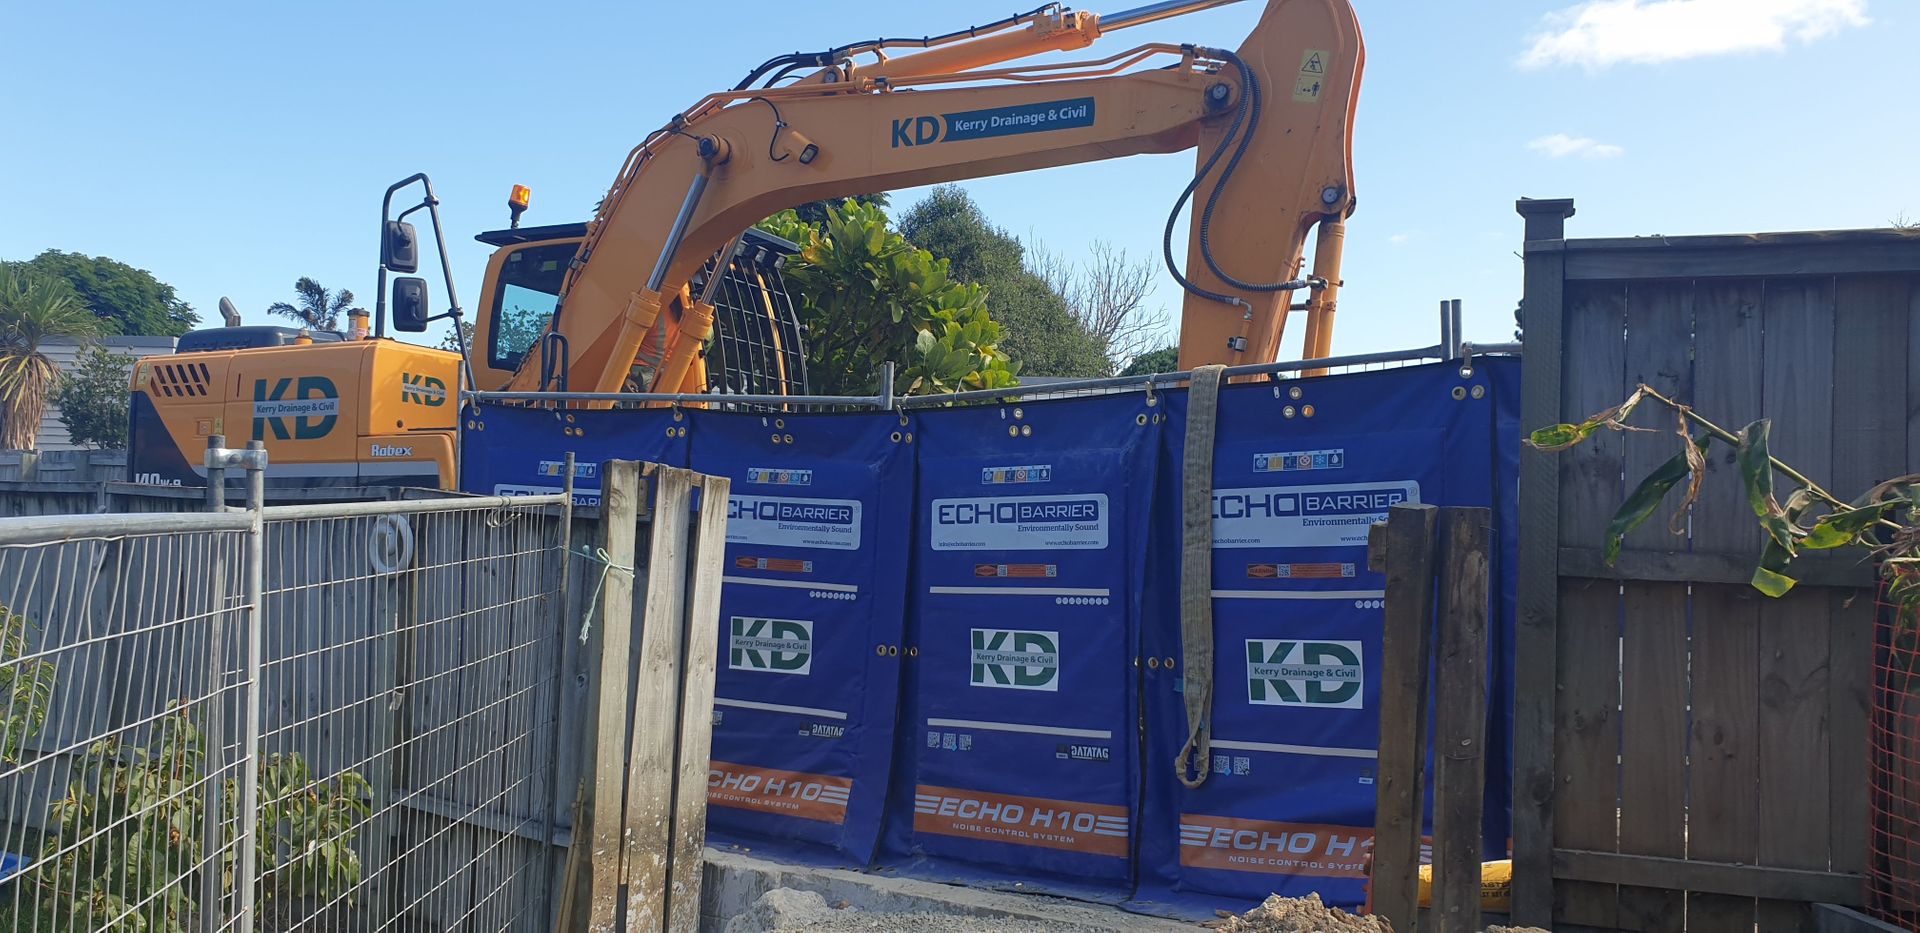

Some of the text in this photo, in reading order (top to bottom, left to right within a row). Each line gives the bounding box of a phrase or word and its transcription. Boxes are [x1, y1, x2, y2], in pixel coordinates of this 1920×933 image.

[955, 105, 1086, 132] Kerry Drainage & Civil
[892, 115, 940, 148] KD
[402, 372, 447, 407] KD
[252, 376, 340, 440] KD
[256, 401, 336, 415] Kerry Drainage & Civil
[371, 444, 413, 457] Robex
[726, 500, 850, 521] CHO BARRIER
[1306, 493, 1402, 511] BARRIER
[939, 502, 1095, 524] ECHO BARRIER
[1302, 515, 1377, 527] Environmentally
[778, 523, 852, 533] Environmentally Sound
[1018, 523, 1099, 532] Environmentally Sound
[731, 618, 811, 670] KD
[735, 638, 754, 646] Kerry
[755, 639, 786, 649] Drainage
[792, 642, 807, 650] Civil
[972, 630, 1057, 687] KD
[976, 652, 1053, 664] Kerry Drainage & Civil
[1248, 641, 1361, 703] KD
[1254, 667, 1355, 678] Kerry Drainage & Civil
[1071, 746, 1109, 759] DATATAG
[708, 770, 761, 792] CHO
[723, 794, 762, 805] CONTROL
[764, 800, 800, 810] SYSTEM
[938, 797, 1024, 823] ECHO
[952, 823, 1074, 844] NOISE CONTROL SYSTEM
[1209, 828, 1317, 854] ECHO
[1228, 855, 1364, 871] NOISE CONTROL SYSTE
